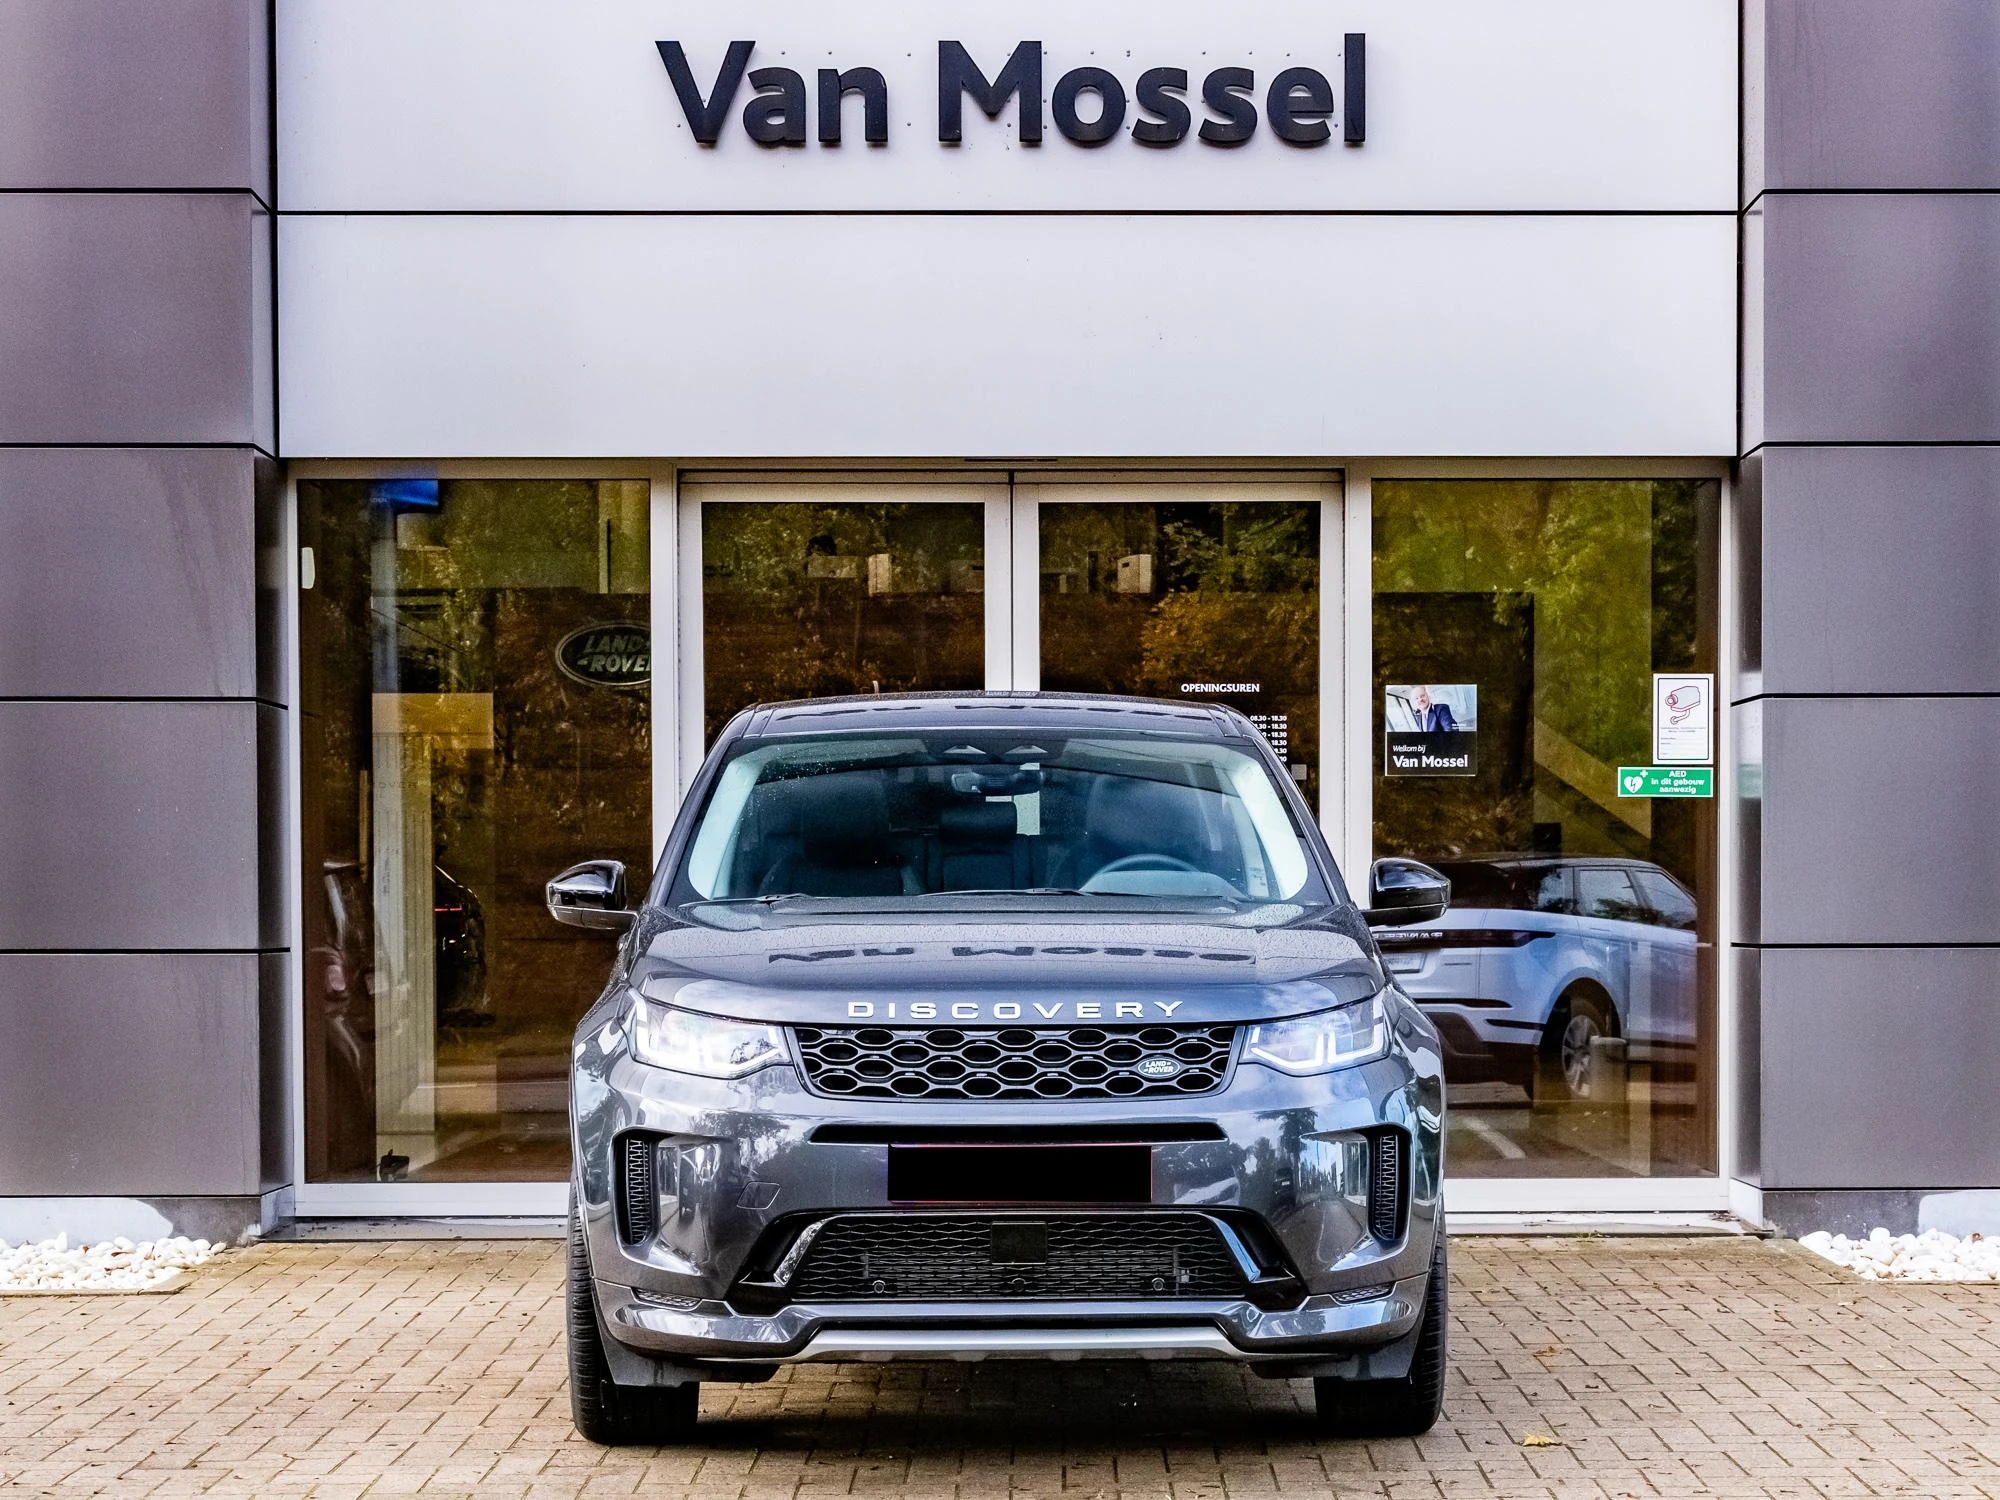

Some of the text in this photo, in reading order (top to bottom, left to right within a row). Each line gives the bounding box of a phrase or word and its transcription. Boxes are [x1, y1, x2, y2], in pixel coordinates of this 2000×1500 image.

[655, 33, 1366, 144] Van Mossel
[584, 635, 645, 653] LAND
[1181, 683, 1260, 693] OPENINGSUREN
[1418, 745, 1426, 754] bij
[1393, 754, 1468, 768] Van Mossel
[1669, 770, 1687, 778] AED
[1673, 778, 1705, 787] gebouw
[1659, 786, 1697, 794] aanwezig
[848, 1000, 1183, 1020] DISCOVERY
